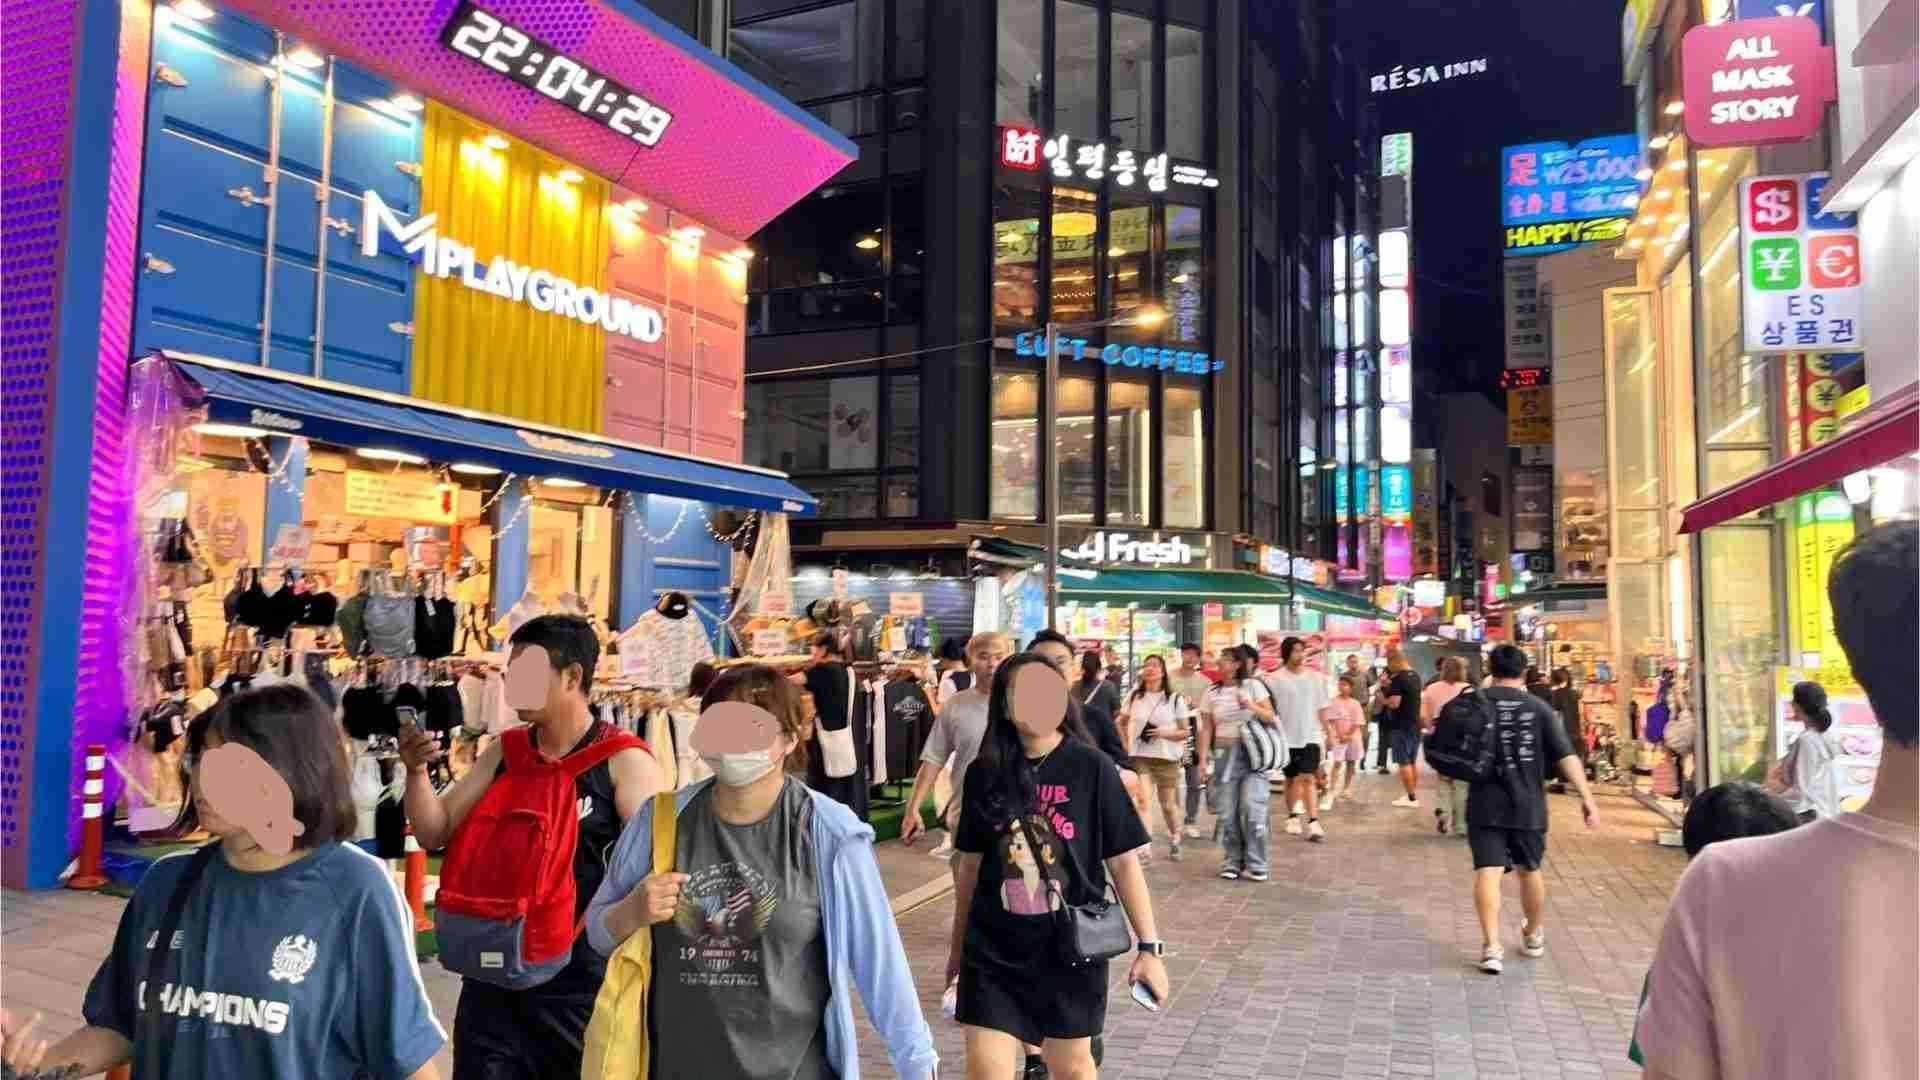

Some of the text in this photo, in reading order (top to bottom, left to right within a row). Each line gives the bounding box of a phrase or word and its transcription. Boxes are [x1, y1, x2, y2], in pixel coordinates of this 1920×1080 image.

[1726, 36, 1779, 61] ALL
[451, 10, 673, 146] 22:04:29
[1443, 59, 1487, 79] INN
[1712, 64, 1794, 93] MASK
[1711, 95, 1799, 124] STORY
[1506, 222, 1582, 247] HAPPY
[437, 236, 663, 343] PLAYGROUND
[1762, 319, 1855, 345] 상품권
[1103, 343, 1209, 375] COFFEE
[1108, 531, 1191, 564] Fresh
